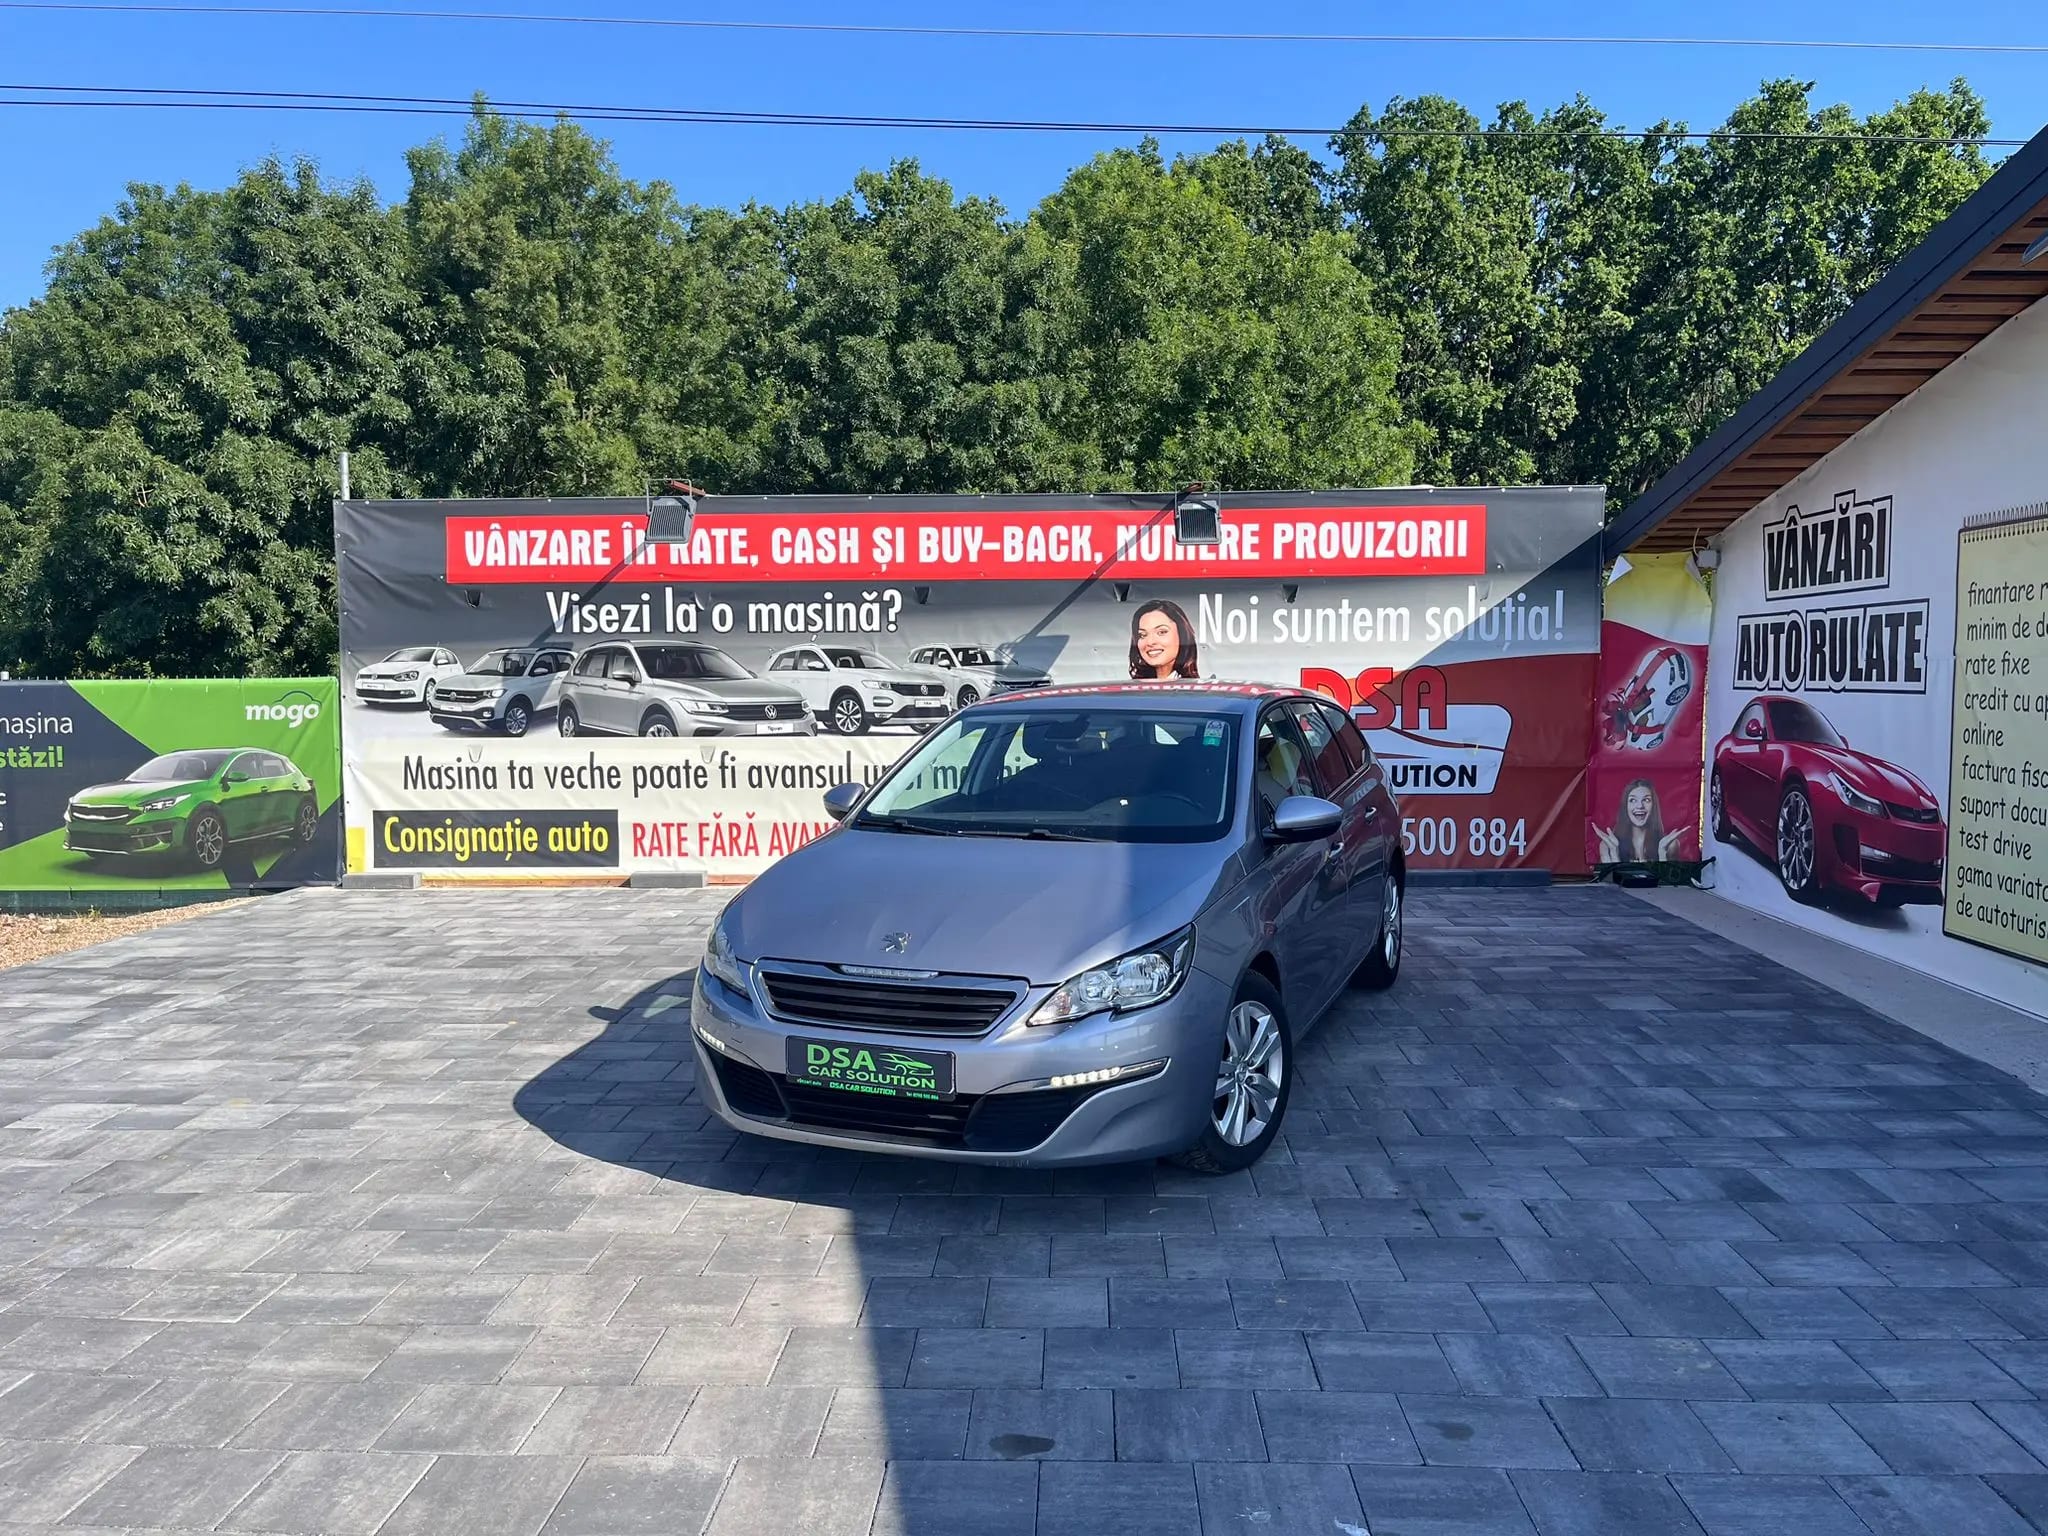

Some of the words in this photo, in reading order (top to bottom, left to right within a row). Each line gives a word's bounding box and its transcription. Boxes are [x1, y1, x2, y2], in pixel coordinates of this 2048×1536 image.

[464, 523, 611, 567] VÂNZARE
[771, 527, 859, 564] CASH
[872, 526, 904, 573] ȘI
[918, 525, 1103, 565] BUY-BACK,
[1273, 519, 1467, 559] PROVIZORII
[1766, 502, 1888, 592] VÂNZĂRI
[545, 591, 651, 634] Visezi
[664, 587, 698, 633] la
[711, 603, 734, 633] o
[1968, 581, 2035, 607] finantare
[1199, 593, 1258, 644] Noi
[1272, 599, 1410, 644] suntem
[1425, 585, 1564, 651] soluția!
[1967, 617, 2007, 641] minim
[2012, 613, 2031, 639] de
[1737, 619, 1805, 683] AUTO
[1808, 611, 1924, 684] RULATE
[1965, 653, 1996, 676] rate
[2001, 650, 2030, 676] fixe
[1300, 665, 1447, 730] DSA
[1964, 686, 2008, 711] credit
[2013, 694, 2030, 713] cu
[245, 703, 320, 728] mogo
[1963, 721, 2004, 747] online
[508, 760, 534, 790] ta
[544, 751, 622, 790] veche
[632, 759, 708, 798] poate
[719, 750, 737, 789] fi
[748, 750, 851, 789] avansul
[1962, 755, 2016, 785] factura
[1960, 795, 2006, 822] suport
[384, 816, 538, 861] Consignație
[548, 820, 609, 853] auto
[632, 822, 689, 857] RATE
[698, 811, 760, 857] FĂRĂ
[1401, 817, 1457, 857] 500
[1468, 817, 1527, 857] 884
[1959, 826, 1989, 852] test
[1993, 830, 2032, 861] drive
[1957, 865, 1993, 889] gama
[1956, 893, 1973, 918] de
[1977, 904, 2048, 940] autoturis
[807, 1043, 877, 1072] DSA
[808, 1065, 842, 1079] CAR
[845, 1069, 936, 1090] SOLUTION
